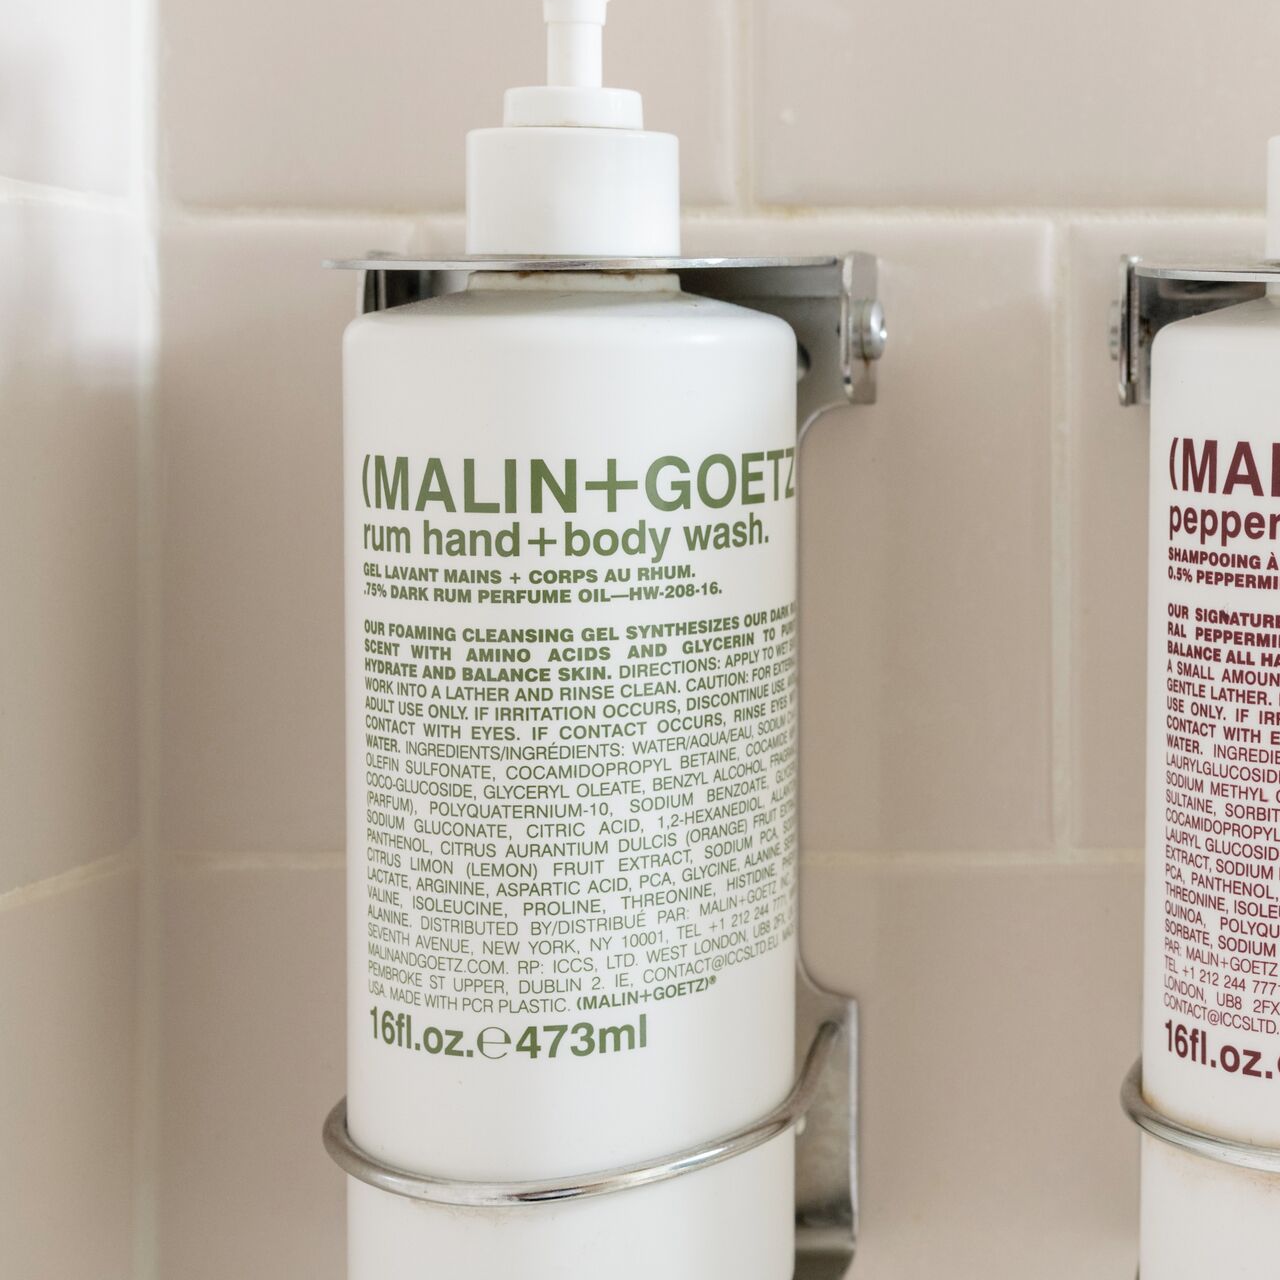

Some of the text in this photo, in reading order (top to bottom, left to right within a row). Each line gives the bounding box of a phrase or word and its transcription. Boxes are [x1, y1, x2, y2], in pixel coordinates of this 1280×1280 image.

[363, 523, 411, 554] rum
[682, 511, 769, 552] wash.
[1168, 546, 1261, 570] SHAMPOOING
[1266, 551, 1279, 571] À
[363, 561, 382, 579] GEL
[384, 564, 440, 583] LAVANT
[443, 568, 502, 585] MAINS
[528, 568, 599, 585] CORPS
[604, 567, 631, 583] AU
[637, 564, 696, 582] RHUM.
[1167, 565, 1193, 584] 0.5%
[363, 581, 388, 598] .75%
[390, 584, 430, 602] DARK
[433, 587, 472, 604] RUM
[477, 589, 572, 605] PERFUME
[1167, 602, 1189, 620] OUR
[364, 618, 385, 637] OUR
[388, 622, 457, 642] FOAMING
[462, 627, 574, 644] CLEANSING
[580, 626, 620, 642] GEL
[625, 615, 740, 641] SYNTHESIZES
[743, 610, 768, 628] OUR
[1167, 620, 1187, 639] RAL
[364, 626, 776, 663] SCENT WITH AMINO ACIDS AND GLYCERIN TO
[1167, 639, 1222, 663] BALANCE
[1225, 649, 1256, 667] ALL
[364, 645, 774, 683] HYDRATE AND BALANCE SKIN. DIRECTIONS: APPLY TO
[1166, 677, 1206, 699] GENTLE
[1210, 685, 1272, 707] LATHER.
[366, 834, 753, 881] CITRUS LIMON (LEMON) FRUIT EXTRACT, SODIUM
[389, 986, 422, 1007] MADE
[424, 993, 458, 1011] WITH
[462, 997, 494, 1014] PCR
[498, 997, 571, 1014] PLASTIC.
